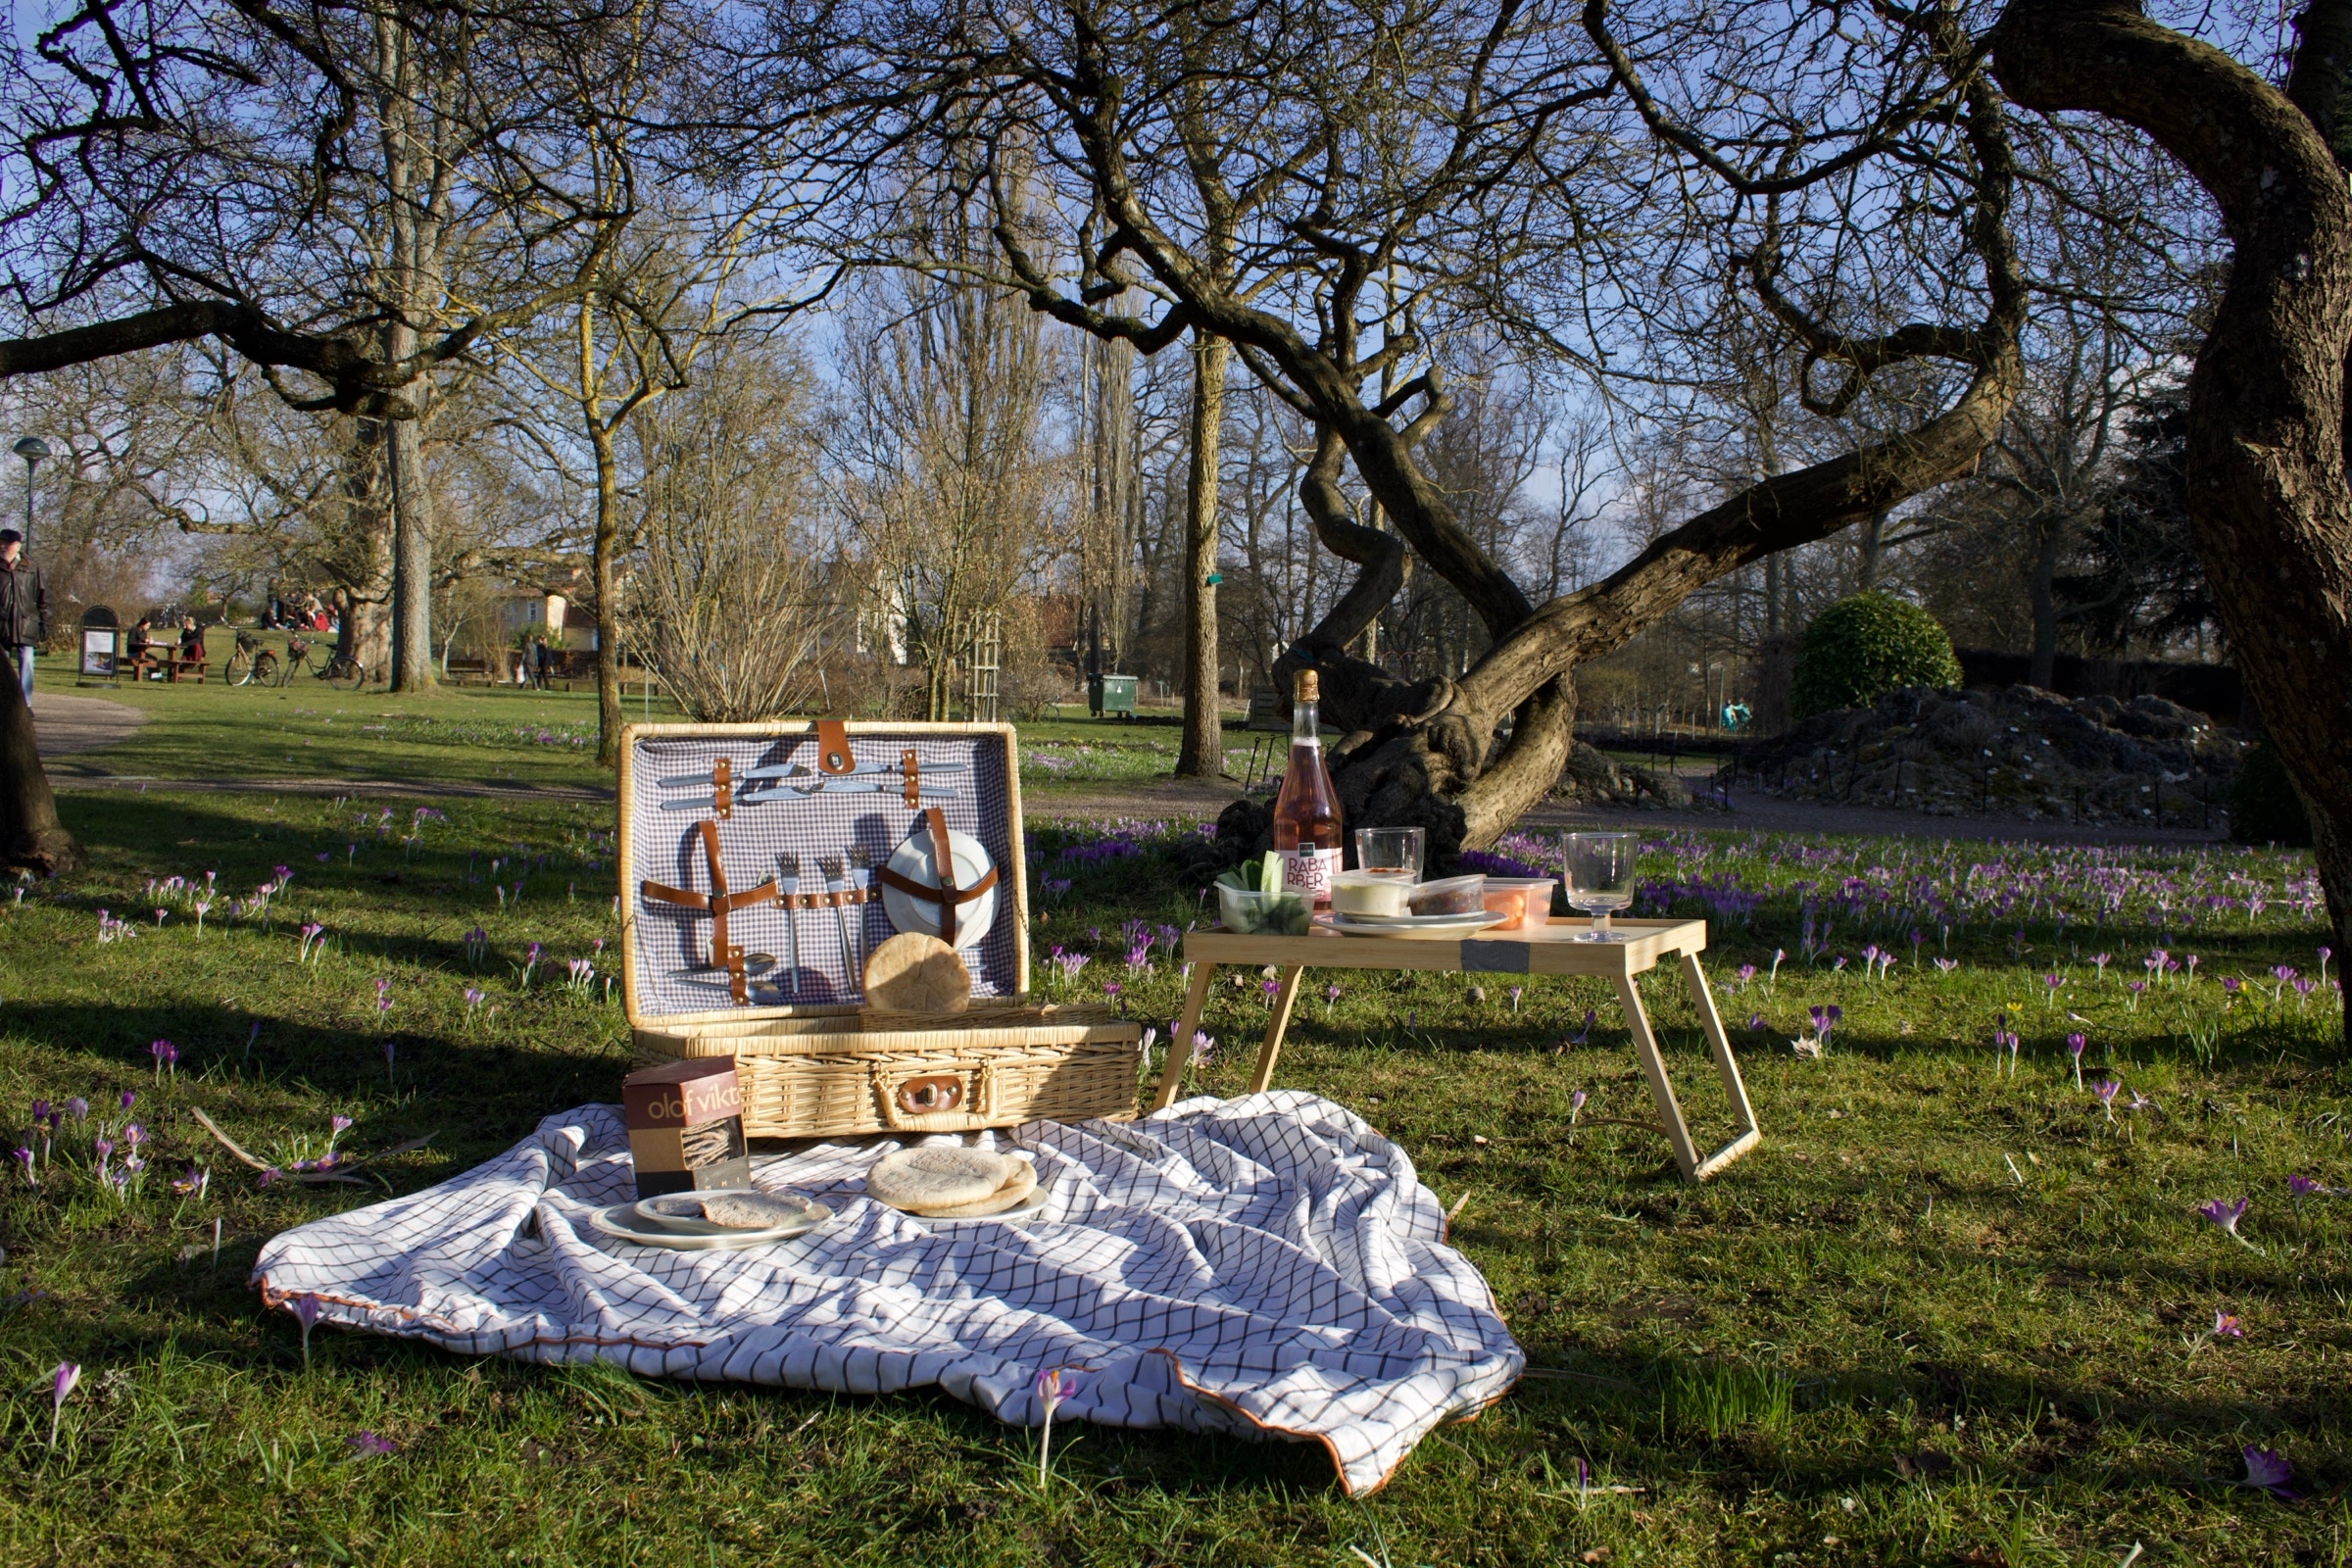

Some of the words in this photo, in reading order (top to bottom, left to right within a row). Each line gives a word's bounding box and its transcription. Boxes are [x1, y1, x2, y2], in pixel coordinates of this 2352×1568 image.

[1288, 858, 1328, 875] RABA
[1287, 872, 1324, 890] RBER
[648, 1089, 694, 1119] olof
